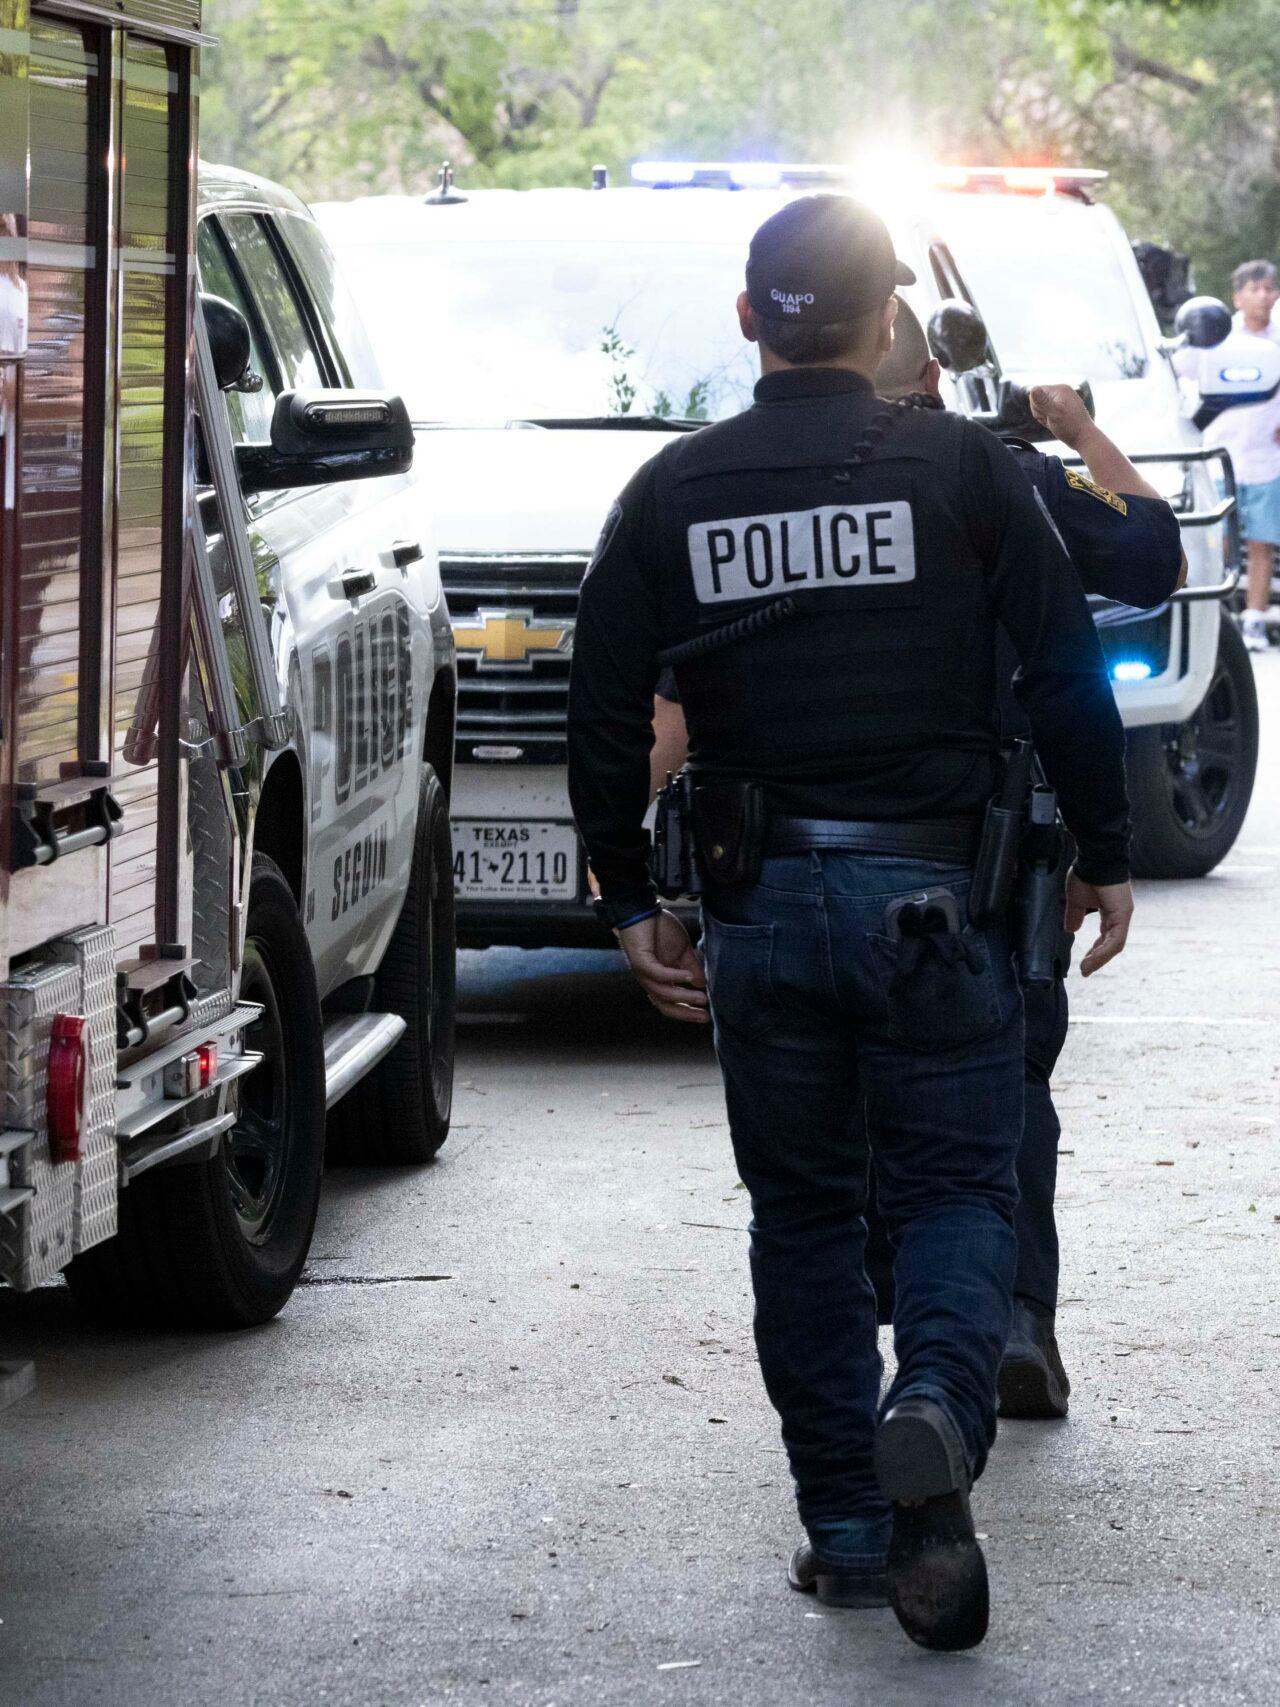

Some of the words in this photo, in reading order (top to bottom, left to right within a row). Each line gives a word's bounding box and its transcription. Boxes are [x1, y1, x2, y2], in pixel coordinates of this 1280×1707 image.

[770, 288, 815, 305] GUAPO
[706, 510, 897, 594] POLICE
[311, 599, 413, 825] POLICE
[472, 827, 531, 841] TEXAS
[483, 841, 518, 849] EXEMPT
[331, 820, 388, 922] SEGUIN
